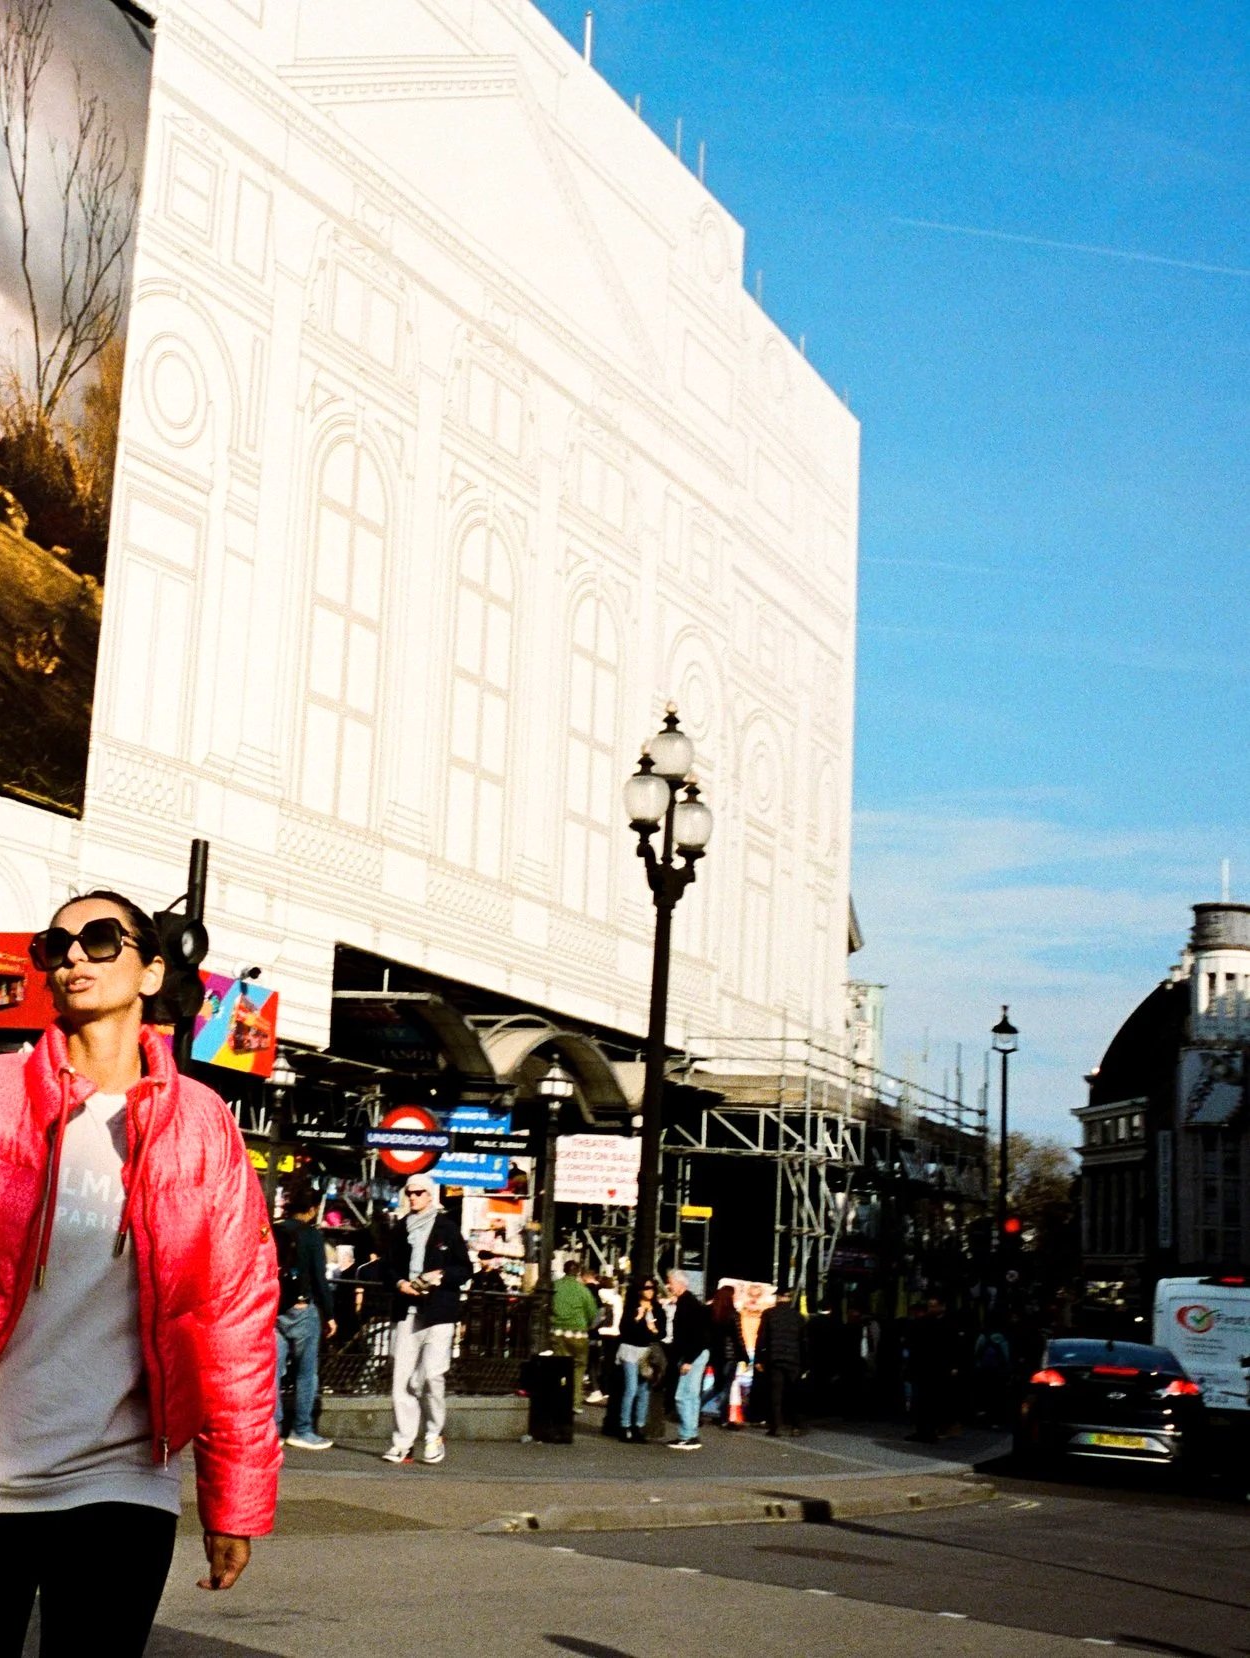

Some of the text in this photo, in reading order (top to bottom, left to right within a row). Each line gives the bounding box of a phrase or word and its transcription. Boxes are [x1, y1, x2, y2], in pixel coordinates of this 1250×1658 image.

[366, 1132, 450, 1148] UNDERGROUND
[573, 1138, 618, 1148] THEATRE
[557, 1151, 591, 1160] CKETS
